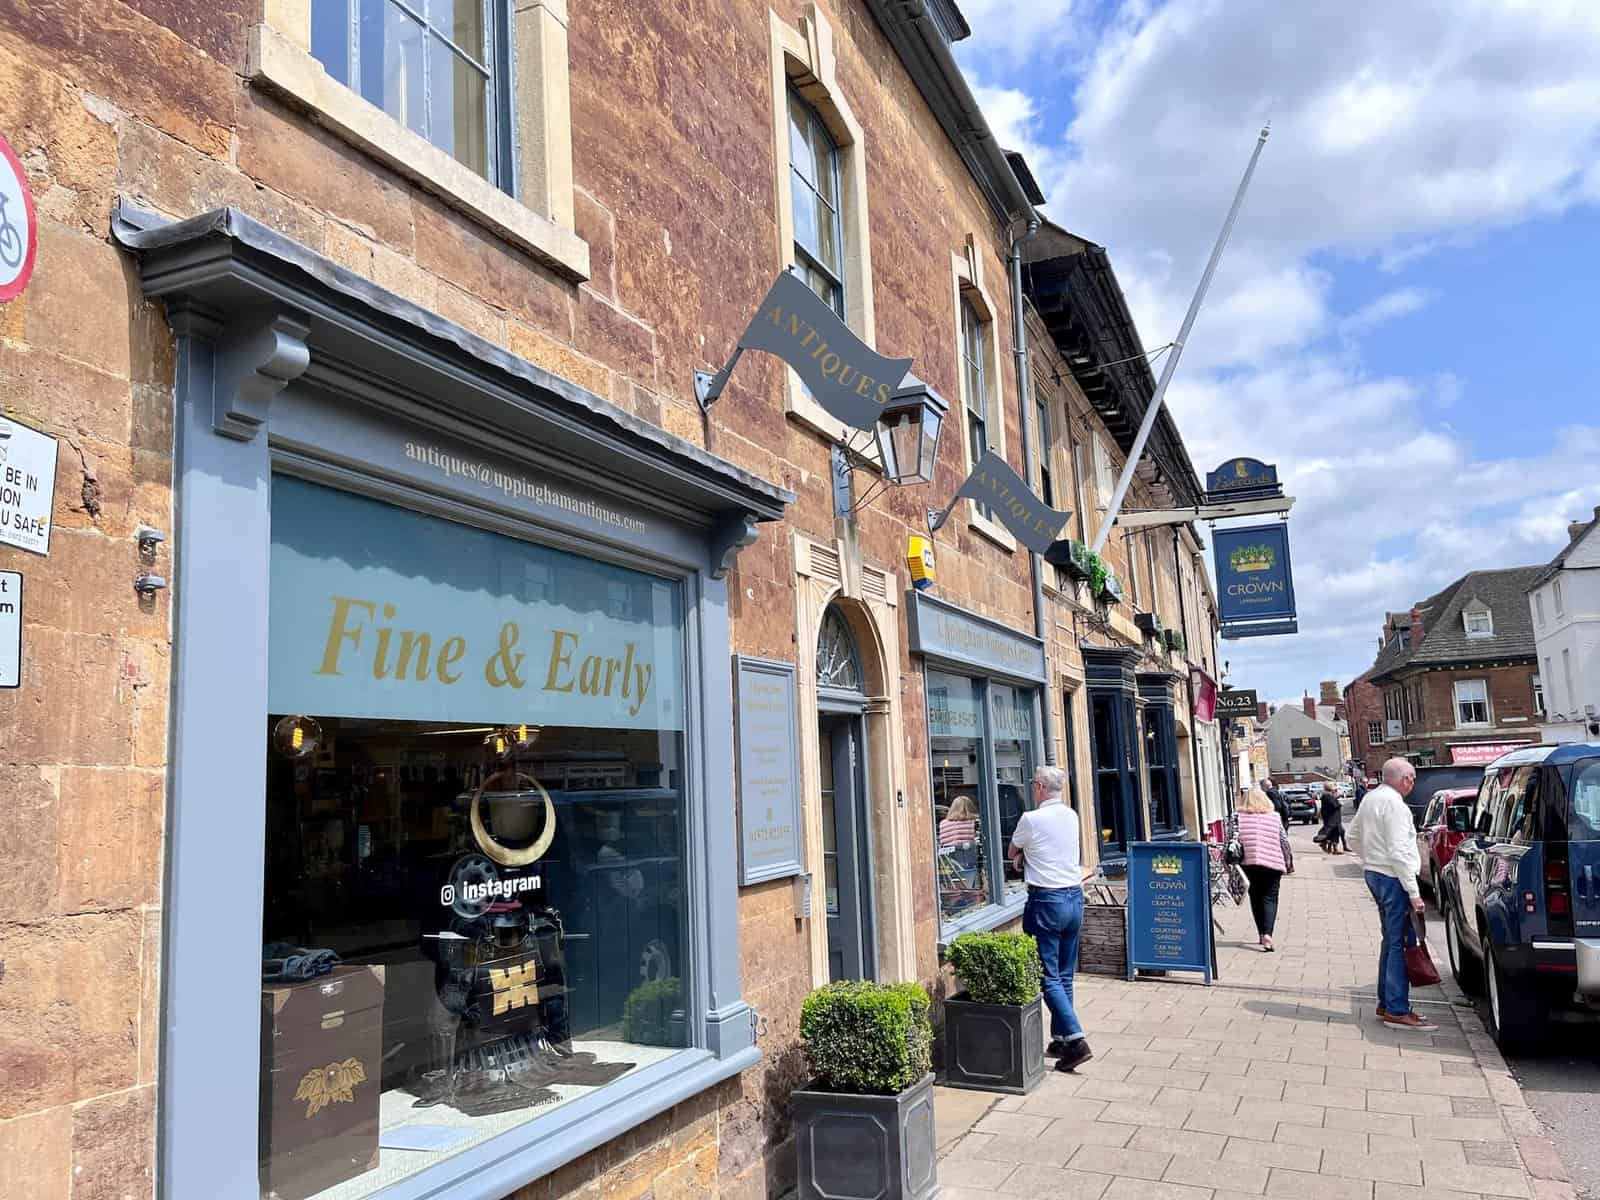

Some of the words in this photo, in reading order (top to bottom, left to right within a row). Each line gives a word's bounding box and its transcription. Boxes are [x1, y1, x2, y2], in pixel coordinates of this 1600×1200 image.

[766, 304, 892, 404] ANTIQUES
[5, 466, 22, 486] BE
[26, 474, 38, 491] IN
[405, 440, 646, 534] antiques@uppinghamantiques.com
[14, 513, 45, 537] SAFE
[1227, 581, 1284, 596] CROWN
[312, 594, 466, 684] Fine
[484, 620, 527, 690] &
[541, 628, 652, 717] Early
[1216, 696, 1252, 708] No.23
[463, 875, 541, 902] instagram
[1148, 881, 1187, 890] CROWN
